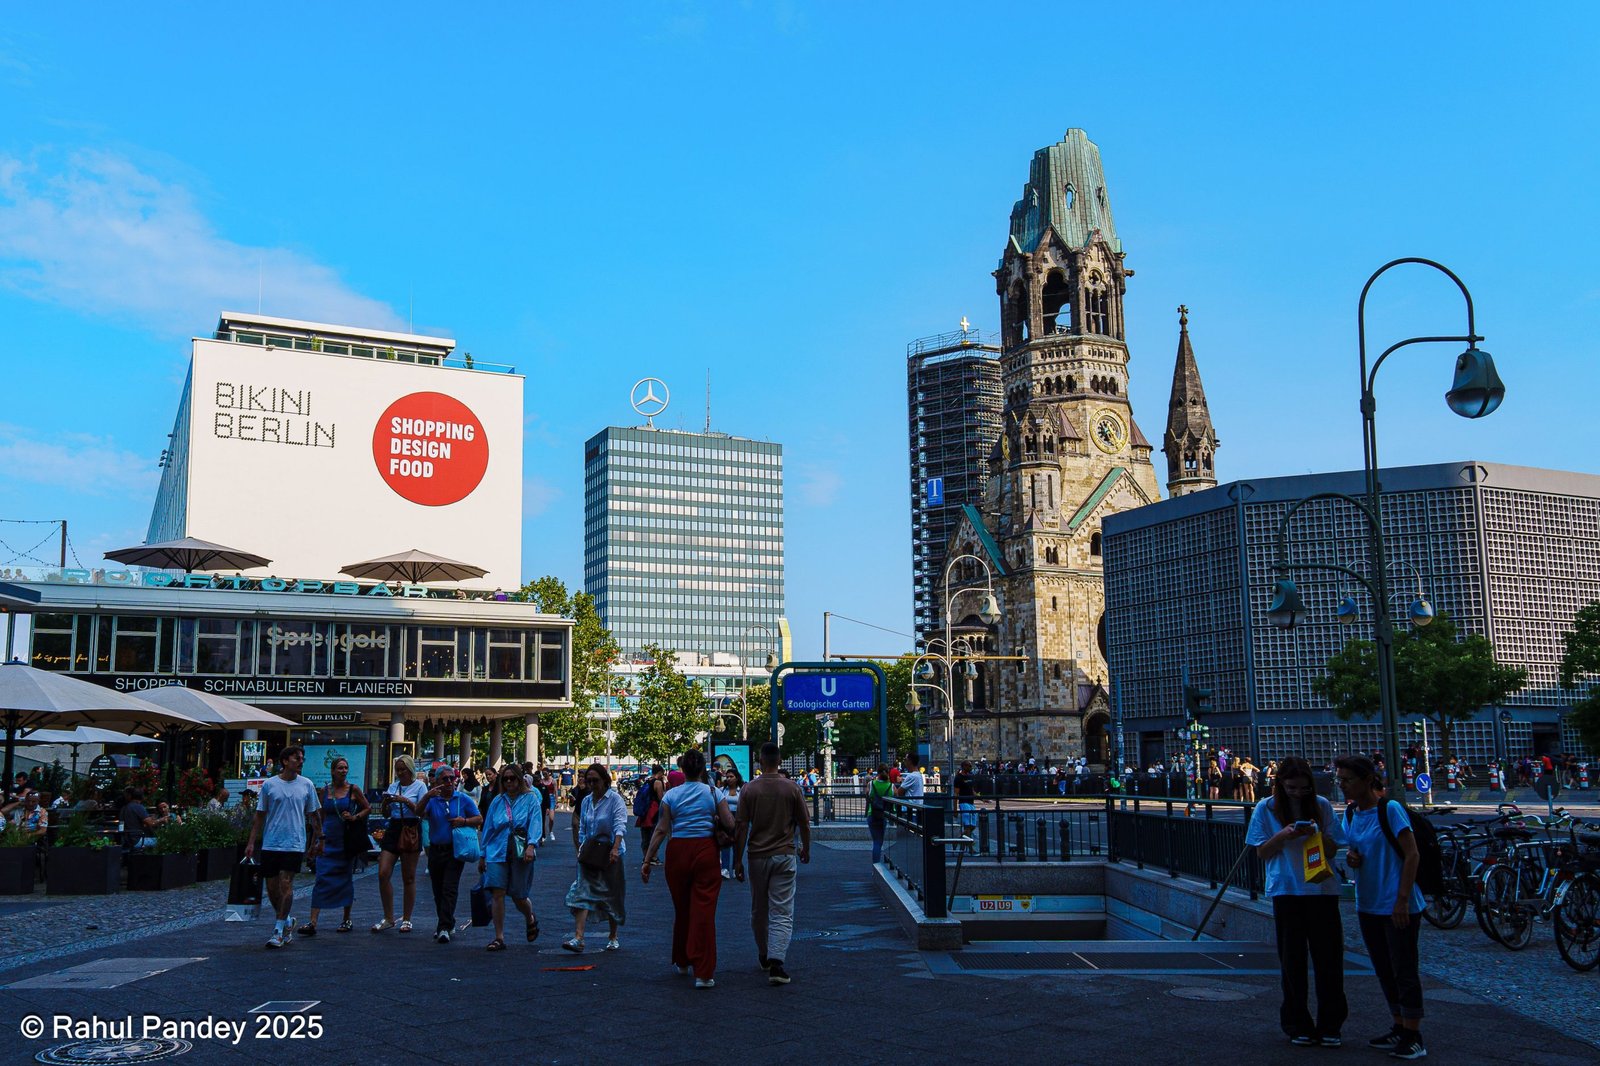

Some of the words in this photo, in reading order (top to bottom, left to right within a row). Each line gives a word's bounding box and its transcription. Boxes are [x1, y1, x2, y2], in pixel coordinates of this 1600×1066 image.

[215, 381, 311, 416] BIKINI
[214, 412, 335, 448] BERLIN
[391, 416, 475, 442] SHOPPING
[390, 438, 451, 459] DESIGN
[389, 458, 434, 478] FOOD
[266, 626, 390, 652] Spreegold
[115, 677, 188, 690] SHOPPEN
[204, 679, 325, 693] SCHNABULIEREN
[339, 681, 413, 694] FLANIEREN
[821, 677, 837, 697] U
[787, 699, 840, 710] Zoologischer
[841, 699, 870, 709] Garten
[982, 901, 994, 910] U2
[999, 901, 1011, 910] U9
